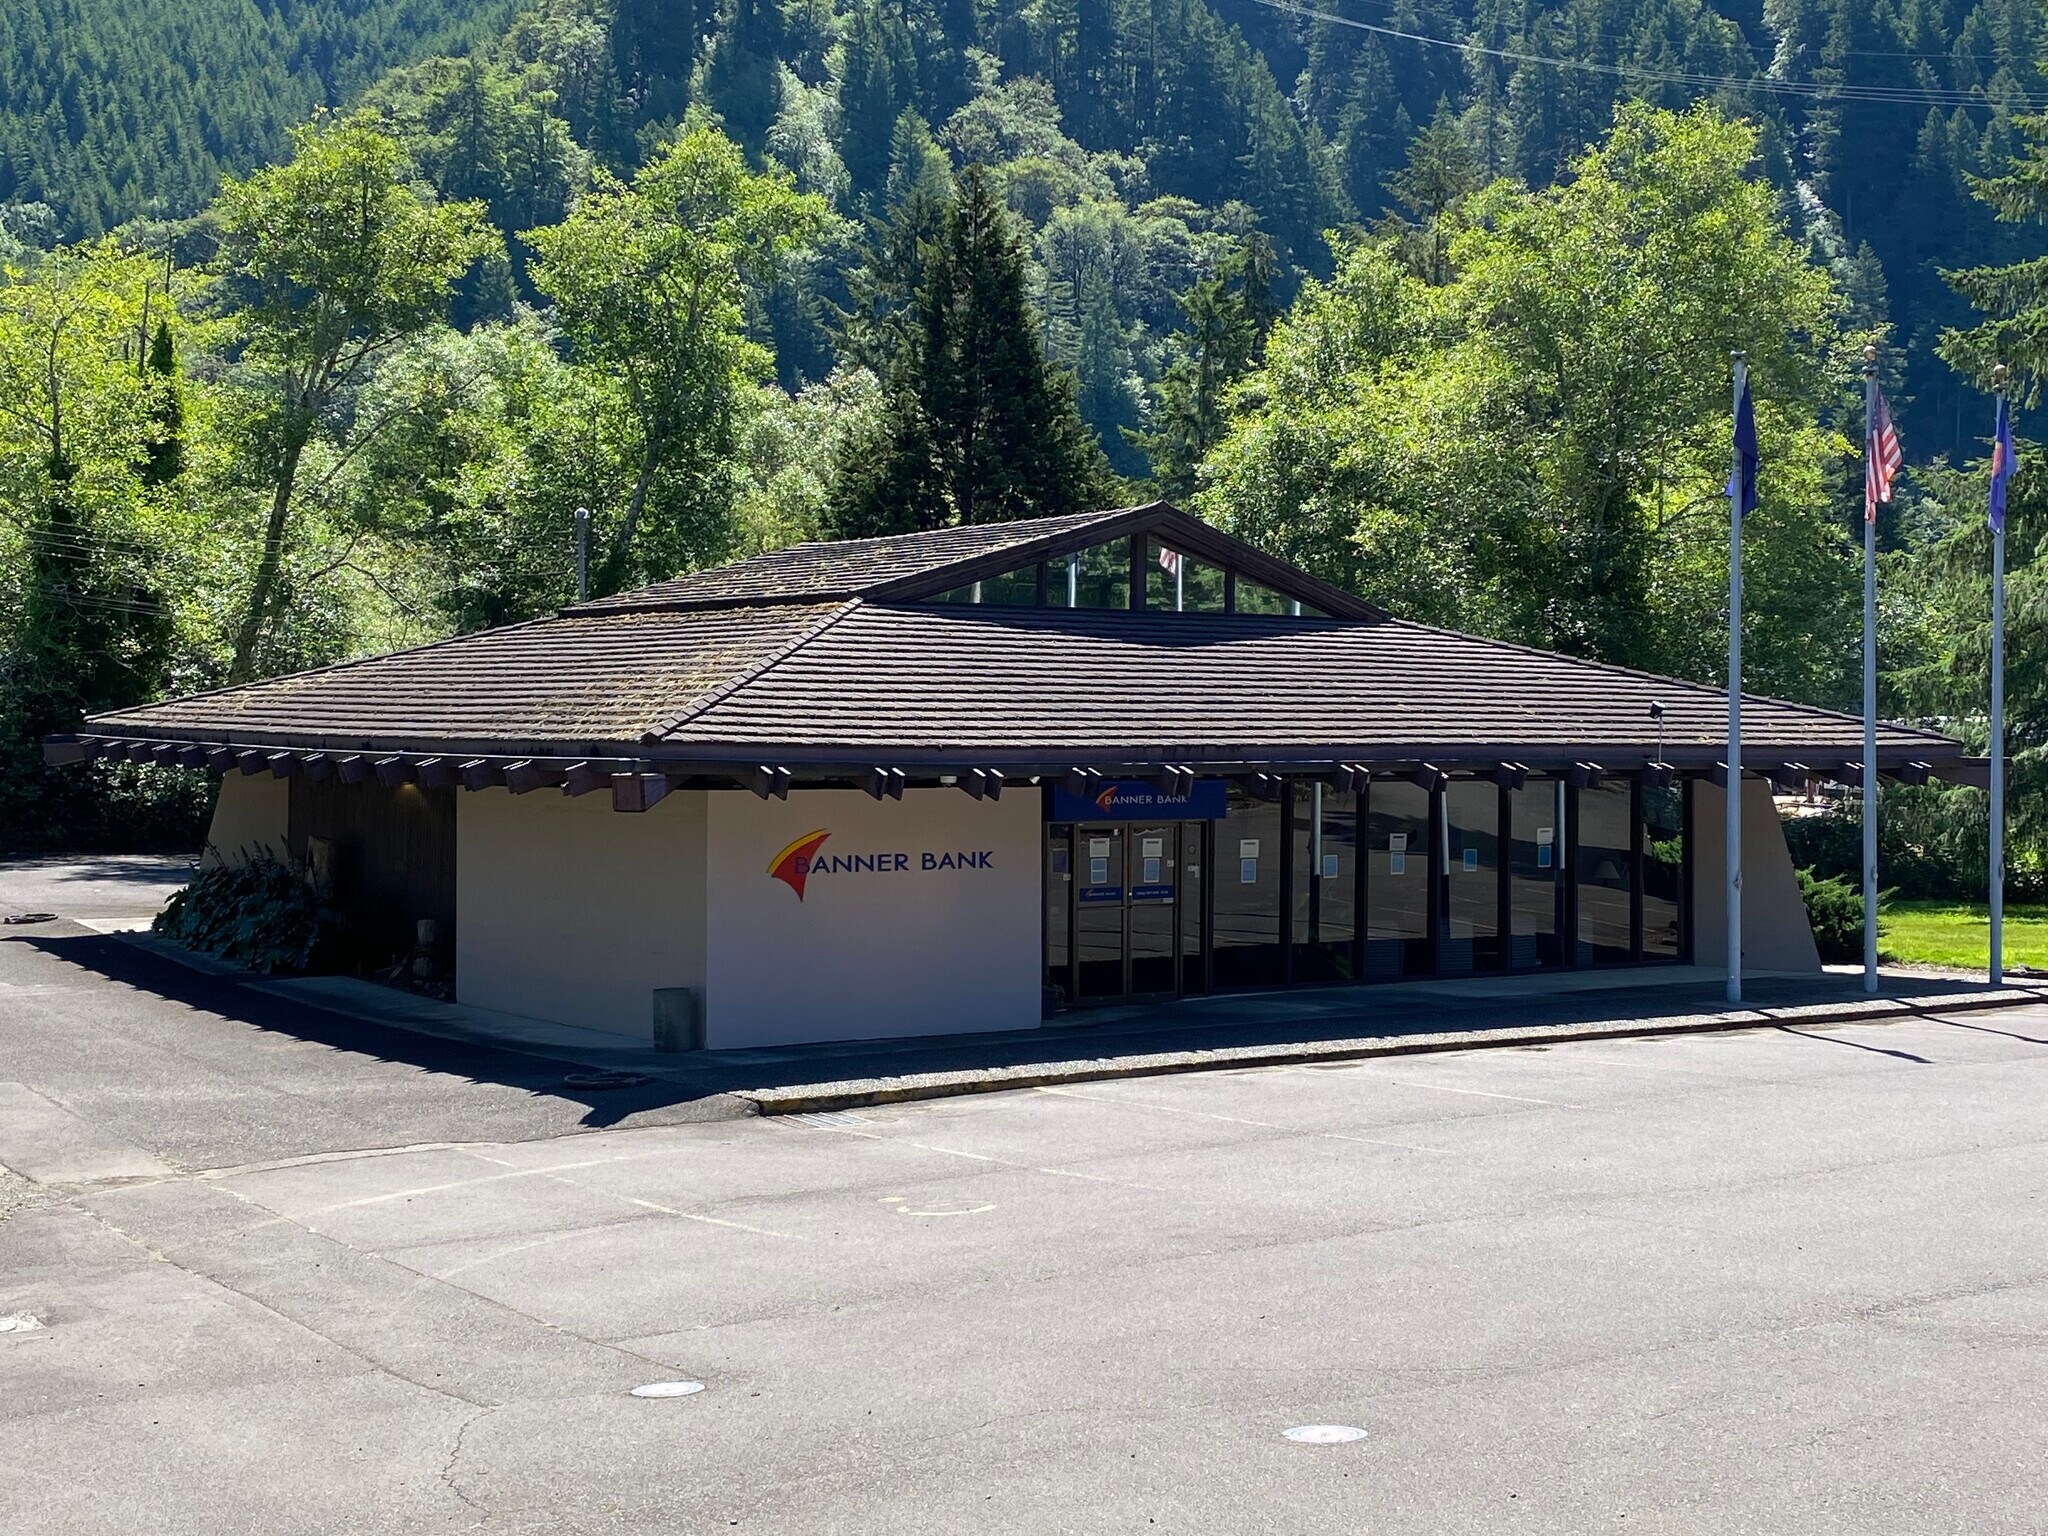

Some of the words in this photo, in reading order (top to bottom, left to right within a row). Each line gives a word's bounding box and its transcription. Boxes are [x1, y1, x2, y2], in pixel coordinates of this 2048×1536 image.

[1105, 795, 1153, 805] BANNER
[1157, 795, 1187, 804] BANK
[795, 853, 909, 874] BANNER
[921, 851, 994, 870] BANK
